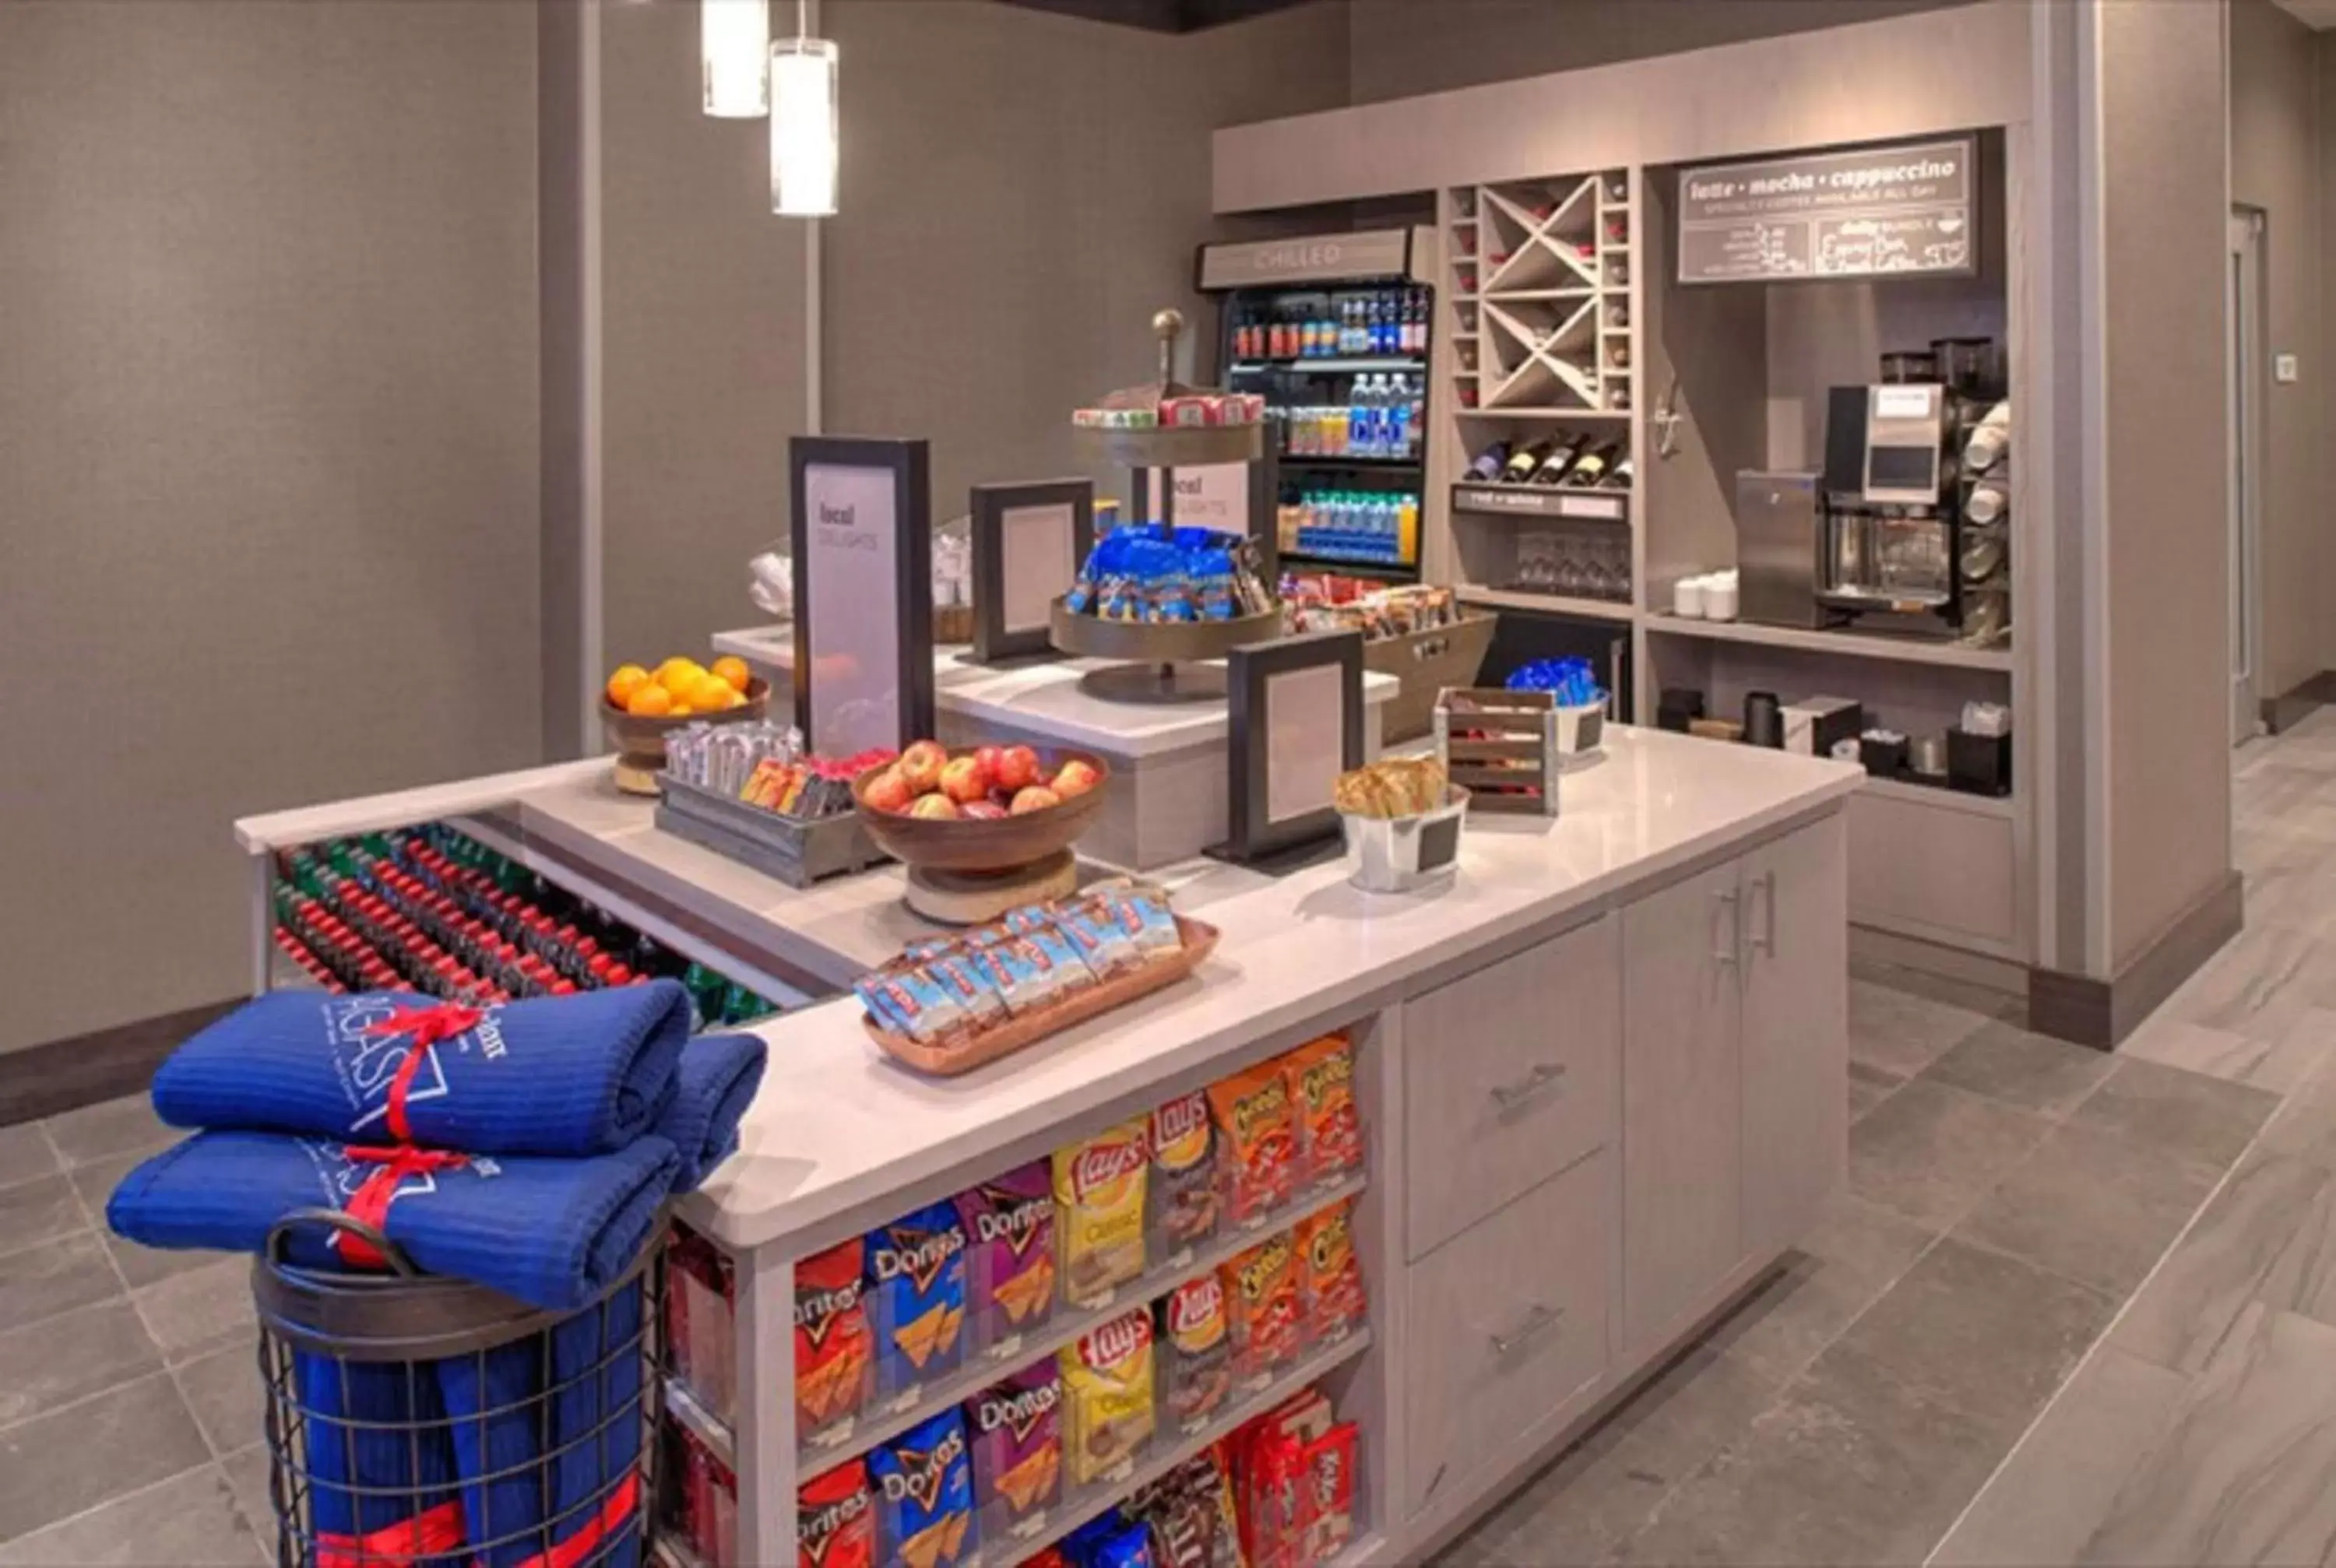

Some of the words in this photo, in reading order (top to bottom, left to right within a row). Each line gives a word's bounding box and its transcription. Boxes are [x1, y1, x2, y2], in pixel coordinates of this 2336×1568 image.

[1749, 172, 1814, 195] mocha
[1831, 160, 1956, 189] cappuccino
[1254, 244, 1342, 270] CHILLED
[819, 501, 855, 526] local
